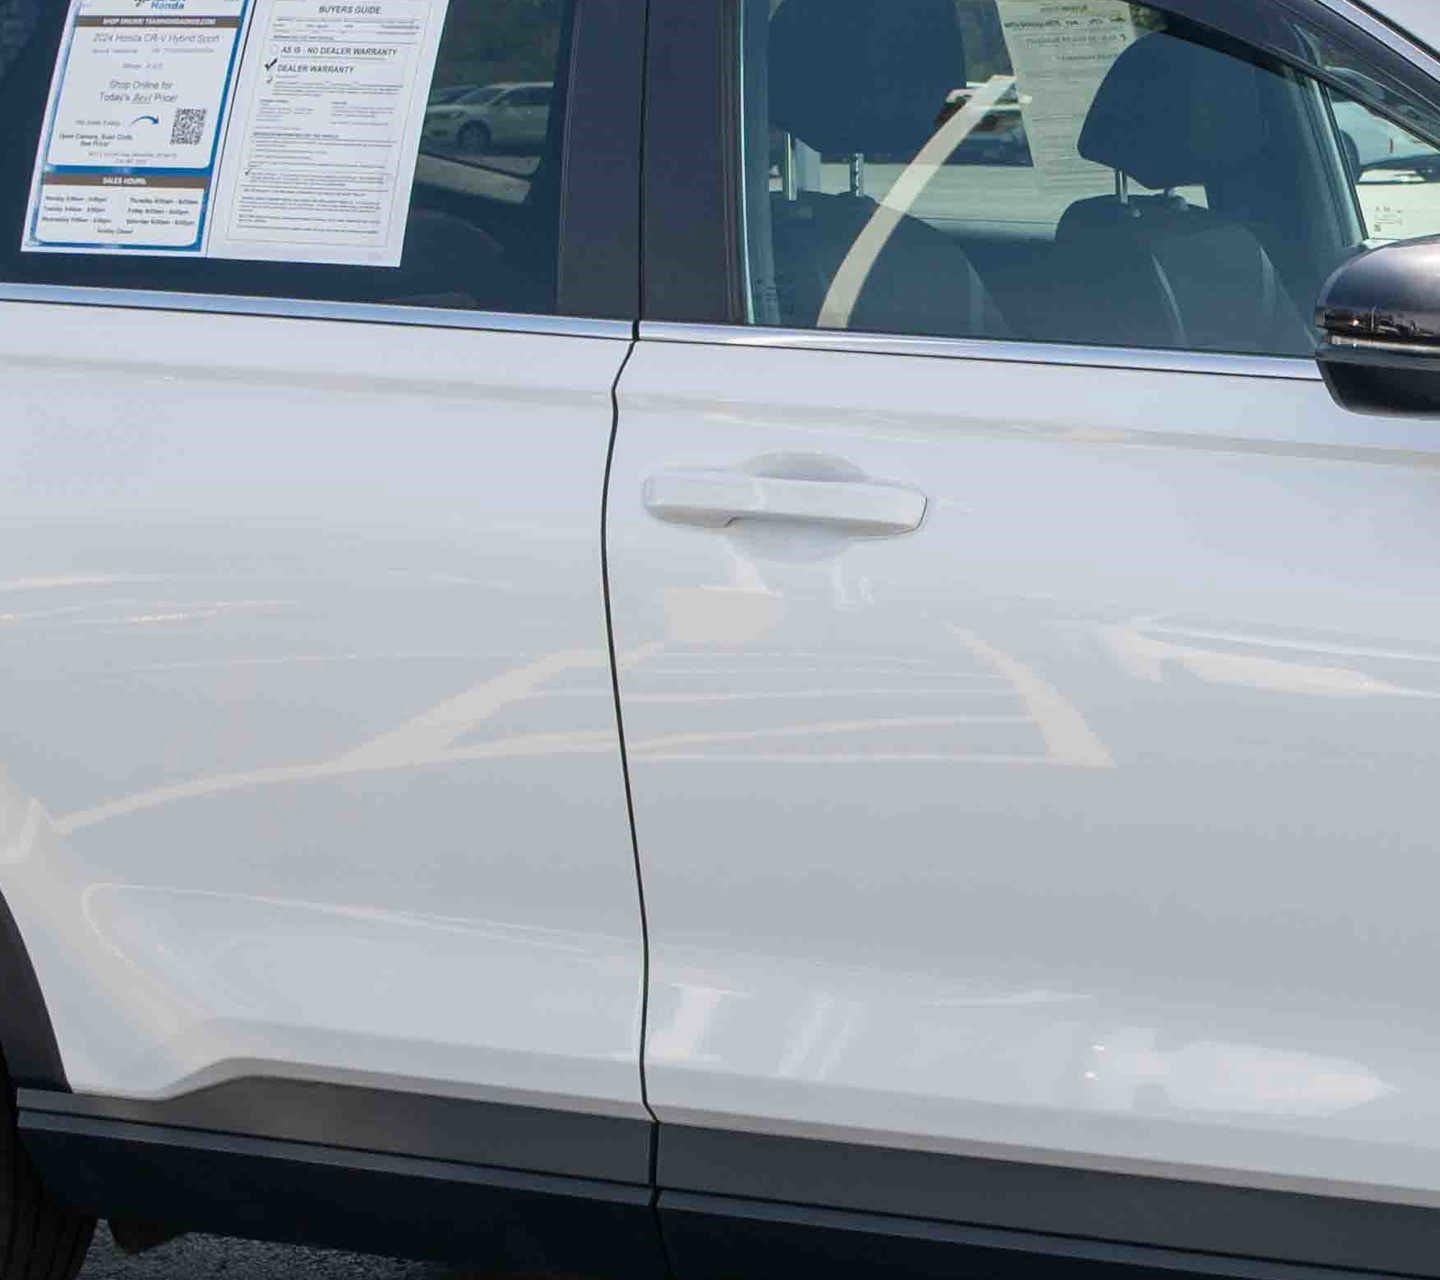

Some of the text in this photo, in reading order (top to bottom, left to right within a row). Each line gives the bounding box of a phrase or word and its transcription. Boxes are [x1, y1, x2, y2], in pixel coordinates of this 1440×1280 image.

[319, 5, 382, 15] BUYERS GUIDE
[115, 33, 142, 43] Honda
[280, 46, 292, 55] AS
[307, 47, 320, 55] NO
[321, 47, 352, 56] DEALER
[353, 48, 398, 57] WARRANTY
[277, 63, 355, 74] DEALER WARRANTY
[110, 80, 131, 91] Shop
